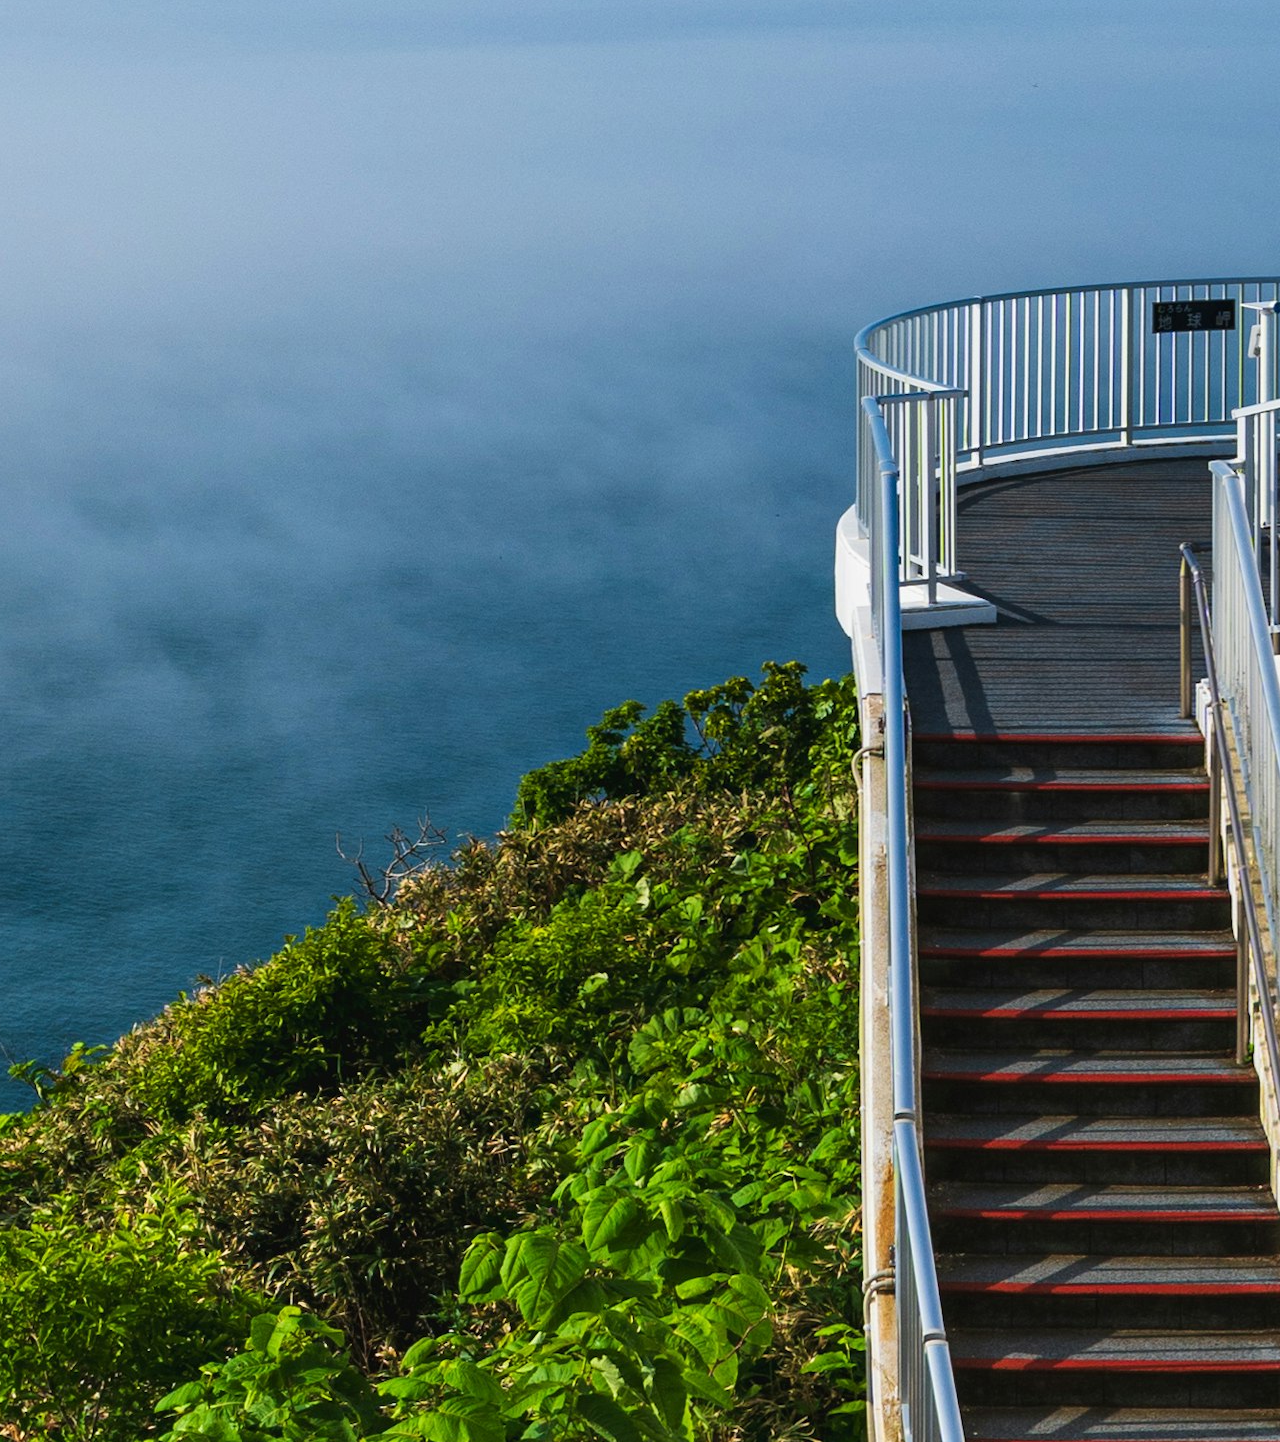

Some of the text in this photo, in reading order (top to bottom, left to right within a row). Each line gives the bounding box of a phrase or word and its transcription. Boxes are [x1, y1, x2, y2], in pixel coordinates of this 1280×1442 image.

[1158, 305, 1192, 313] むろらん
[1158, 311, 1231, 330] 地球岬
